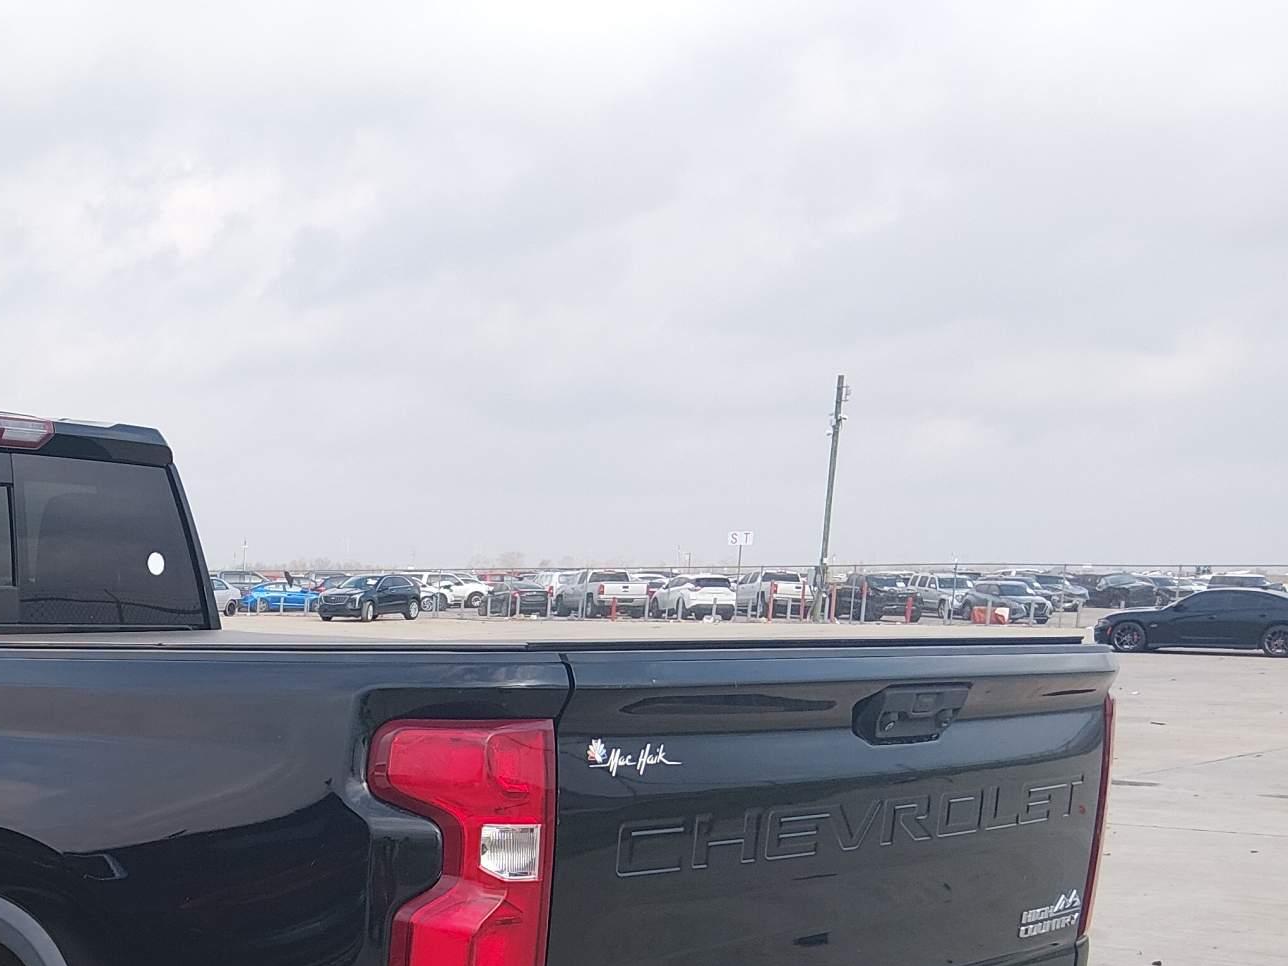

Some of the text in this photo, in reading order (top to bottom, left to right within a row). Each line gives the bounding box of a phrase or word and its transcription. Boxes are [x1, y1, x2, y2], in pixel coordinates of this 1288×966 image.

[592, 743, 681, 777] Mac Haik
[615, 774, 1085, 877] CHEVROLET
[1019, 912, 1079, 938] COUNTRY
[1021, 905, 1056, 924] HIGH
